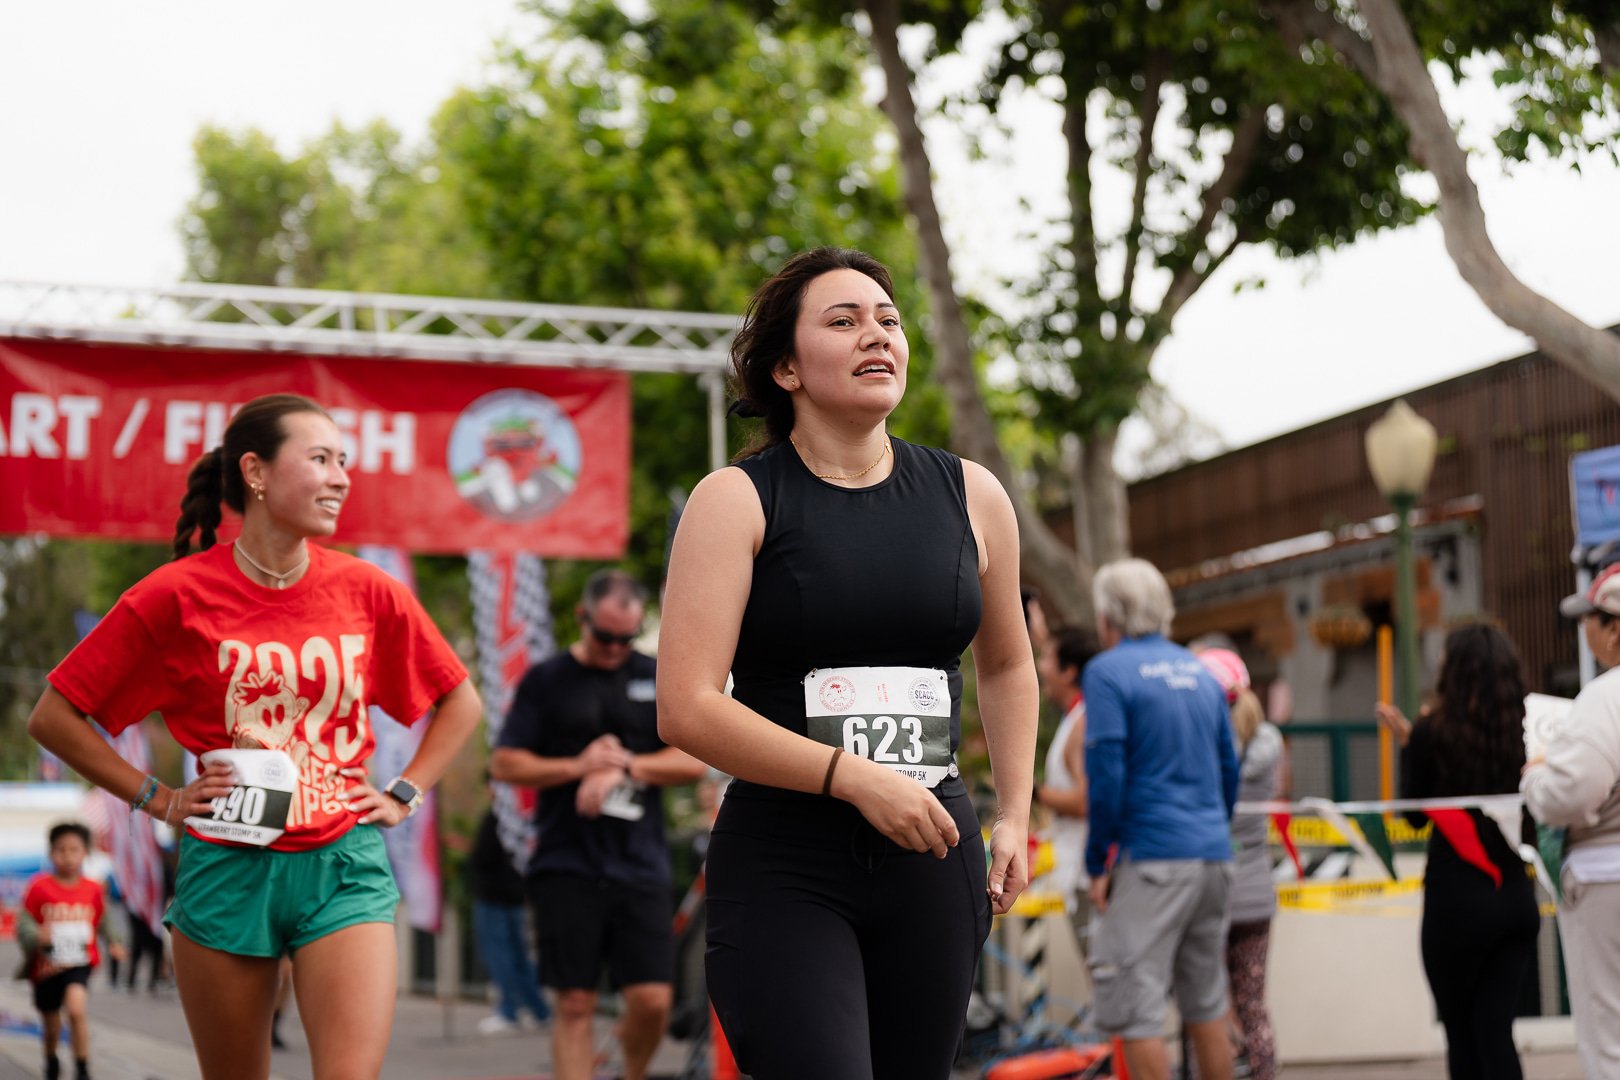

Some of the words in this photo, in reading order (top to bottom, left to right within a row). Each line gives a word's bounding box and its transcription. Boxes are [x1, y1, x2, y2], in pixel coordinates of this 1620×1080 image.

[0, 392, 101, 460] RT
[842, 716, 924, 764] 623
[917, 770, 927, 781] 5K
[210, 786, 267, 826] 490
